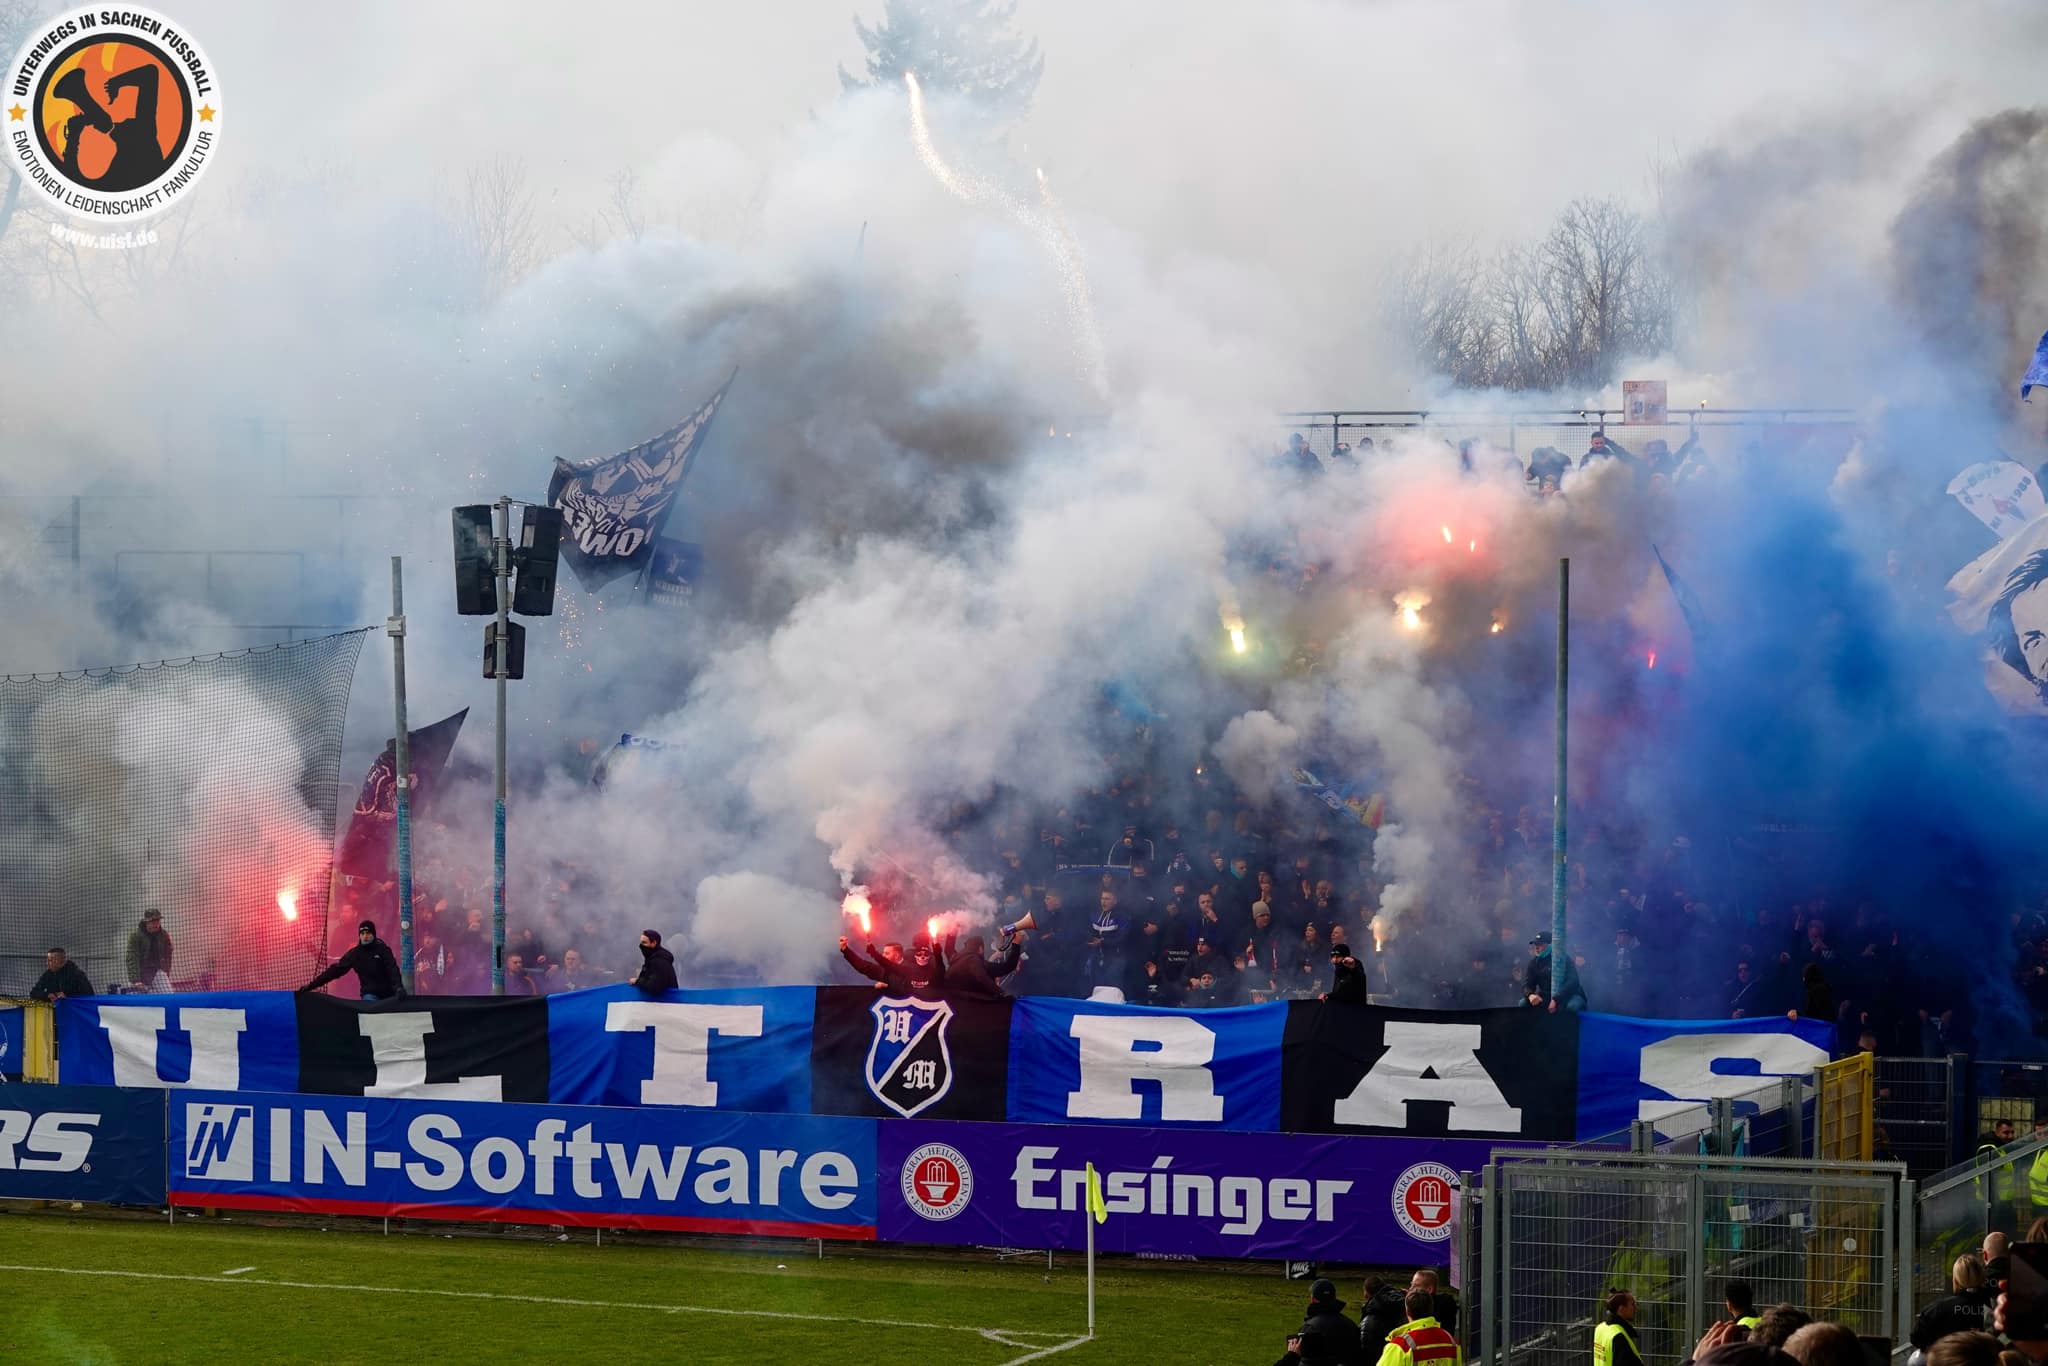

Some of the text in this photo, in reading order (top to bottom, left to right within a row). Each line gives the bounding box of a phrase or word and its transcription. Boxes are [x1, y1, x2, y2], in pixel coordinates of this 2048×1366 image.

[271, 1107, 858, 1211] IN-Software
[912, 1199, 961, 1217] ENSINGEN
[1291, 1261, 1310, 1274] NIKE
